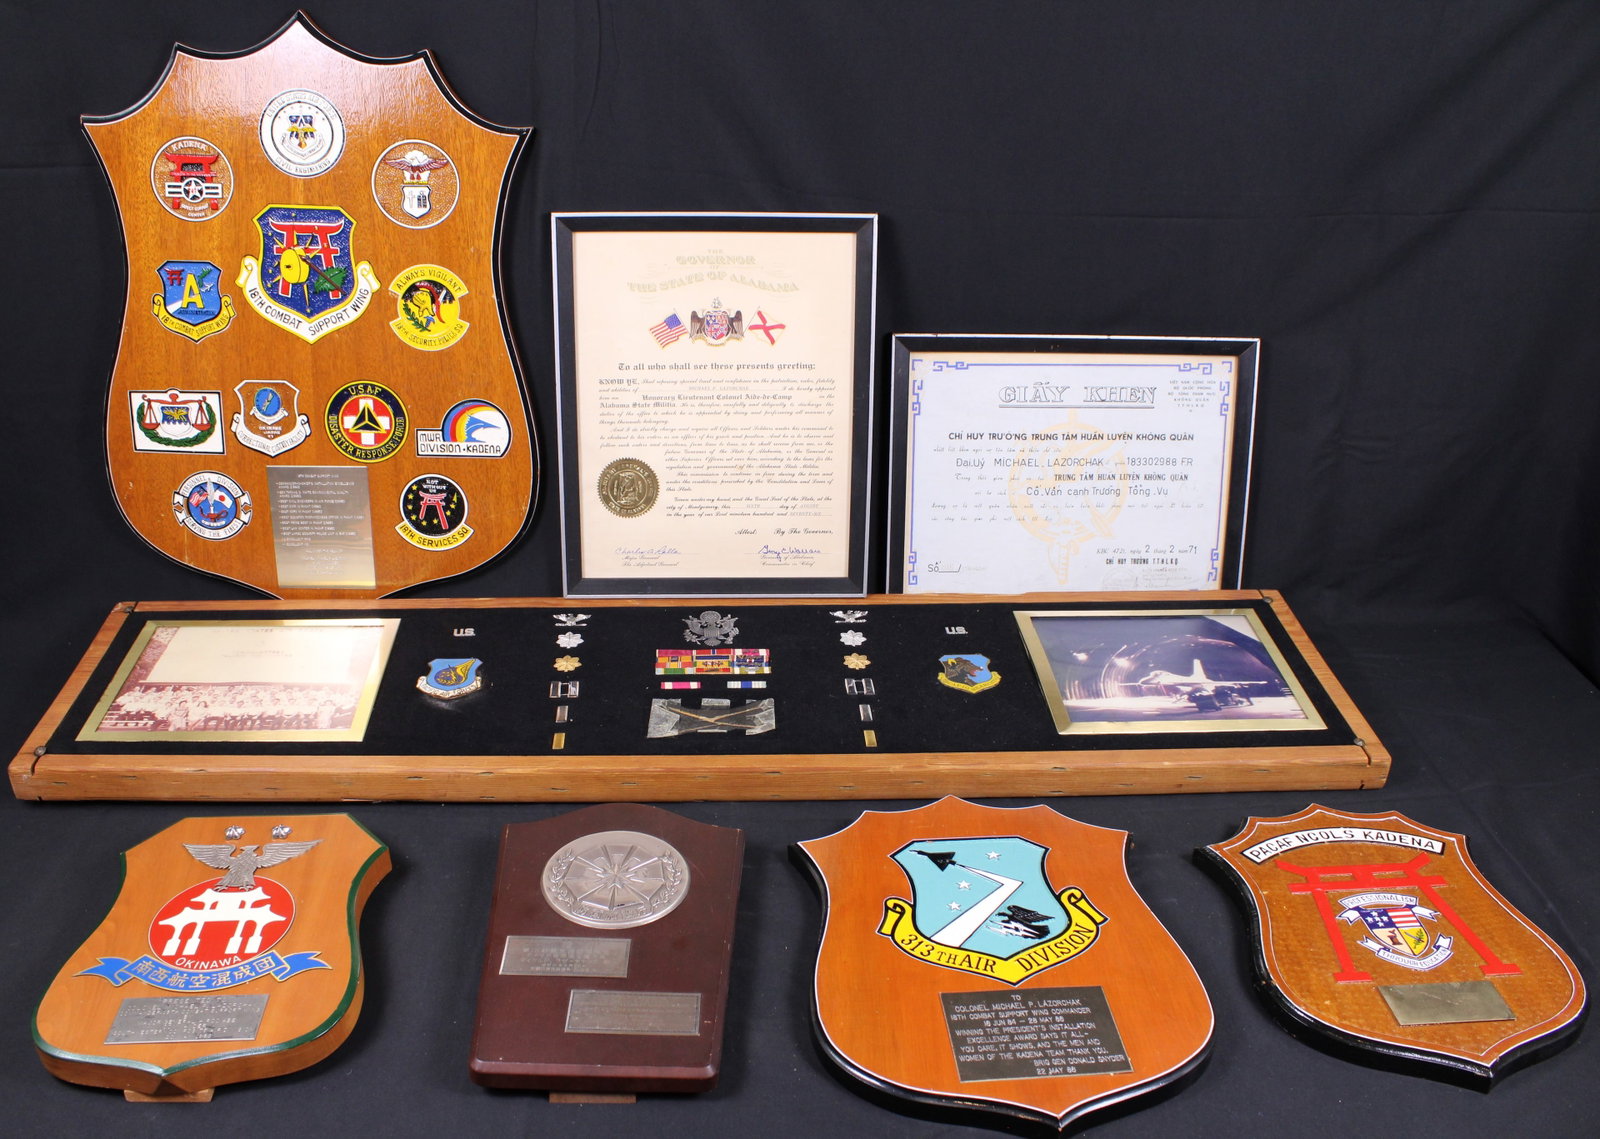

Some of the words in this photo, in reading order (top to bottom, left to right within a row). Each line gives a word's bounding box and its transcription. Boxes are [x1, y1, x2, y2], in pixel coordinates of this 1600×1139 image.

[676, 255, 756, 265] GOVERNOR
[396, 269, 426, 290] ALWAYS
[428, 269, 462, 292] VIGILANT
[659, 272, 705, 292] STATE
[730, 273, 800, 293] ALABAMA
[181, 273, 205, 309] A
[248, 287, 266, 310] 18TH
[264, 304, 302, 330] COMBAT
[308, 308, 351, 336] SUPPORT
[350, 288, 370, 312] WING
[216, 314, 230, 328] WING
[618, 362, 630, 371] To
[648, 363, 666, 372] who
[669, 362, 691, 370] shall
[711, 362, 734, 371] these
[736, 362, 774, 371] presents
[348, 384, 382, 396] USAF
[998, 382, 1070, 404] GIẤY
[1083, 386, 1158, 404] KHEN
[328, 414, 354, 454] DISASTER
[356, 440, 398, 459] RESPONSE
[420, 433, 441, 442] MWR
[966, 432, 984, 440] HUY
[1062, 432, 1078, 441] TÂM
[1136, 432, 1166, 441] KHÔNG
[1169, 432, 1194, 442] QUÂN
[420, 443, 461, 454] DIVISION
[466, 444, 501, 454] KADENA
[1047, 457, 1104, 468] LAZORCHAK
[1127, 456, 1178, 467] 183302988
[1180, 458, 1194, 467] FR
[1080, 472, 1094, 481] TÂM
[1143, 472, 1166, 481] KHÔNG
[1170, 472, 1189, 482] QUÂN
[400, 524, 416, 540] 18TH
[416, 534, 459, 548] SERVICES
[457, 526, 468, 538] SQ
[1144, 544, 1151, 553] 2
[1169, 544, 1176, 553] 2
[1250, 836, 1293, 860] PACAF
[1363, 831, 1435, 850] KADENA
[959, 956, 997, 974] AIR
[1014, 922, 1095, 973] DIVISION
[175, 955, 242, 970] OKINAWA
[132, 956, 276, 989] 南西航空混成団
[954, 1004, 990, 1013] COLONEL
[992, 1002, 1026, 1010] MICHAEL
[1038, 1000, 1082, 1008] LAZORCHAK
[998, 1010, 1028, 1018] SUPPORT
[1051, 1006, 1091, 1015] COMMANDER
[955, 1028, 984, 1036] WINNING
[1002, 1025, 1046, 1034] PRESIDENT'S
[1049, 1022, 1096, 1031] INSTALLATION
[966, 1036, 1011, 1044] EXCELLENCE
[1014, 1033, 1038, 1041] AWARD
[1037, 1041, 1051, 1049] AND
[959, 1054, 985, 1062] WOMEN
[1016, 1050, 1044, 1059] KADENA
[1045, 1048, 1065, 1056] TEAM
[1066, 1048, 1090, 1056] THANK
[1034, 1059, 1050, 1067] BRIG
[1052, 1058, 1067, 1066] GEN
[1068, 1056, 1096, 1064] DONALD
[1098, 1054, 1126, 1062] SNYDER
[1048, 1066, 1063, 1074] MAY
